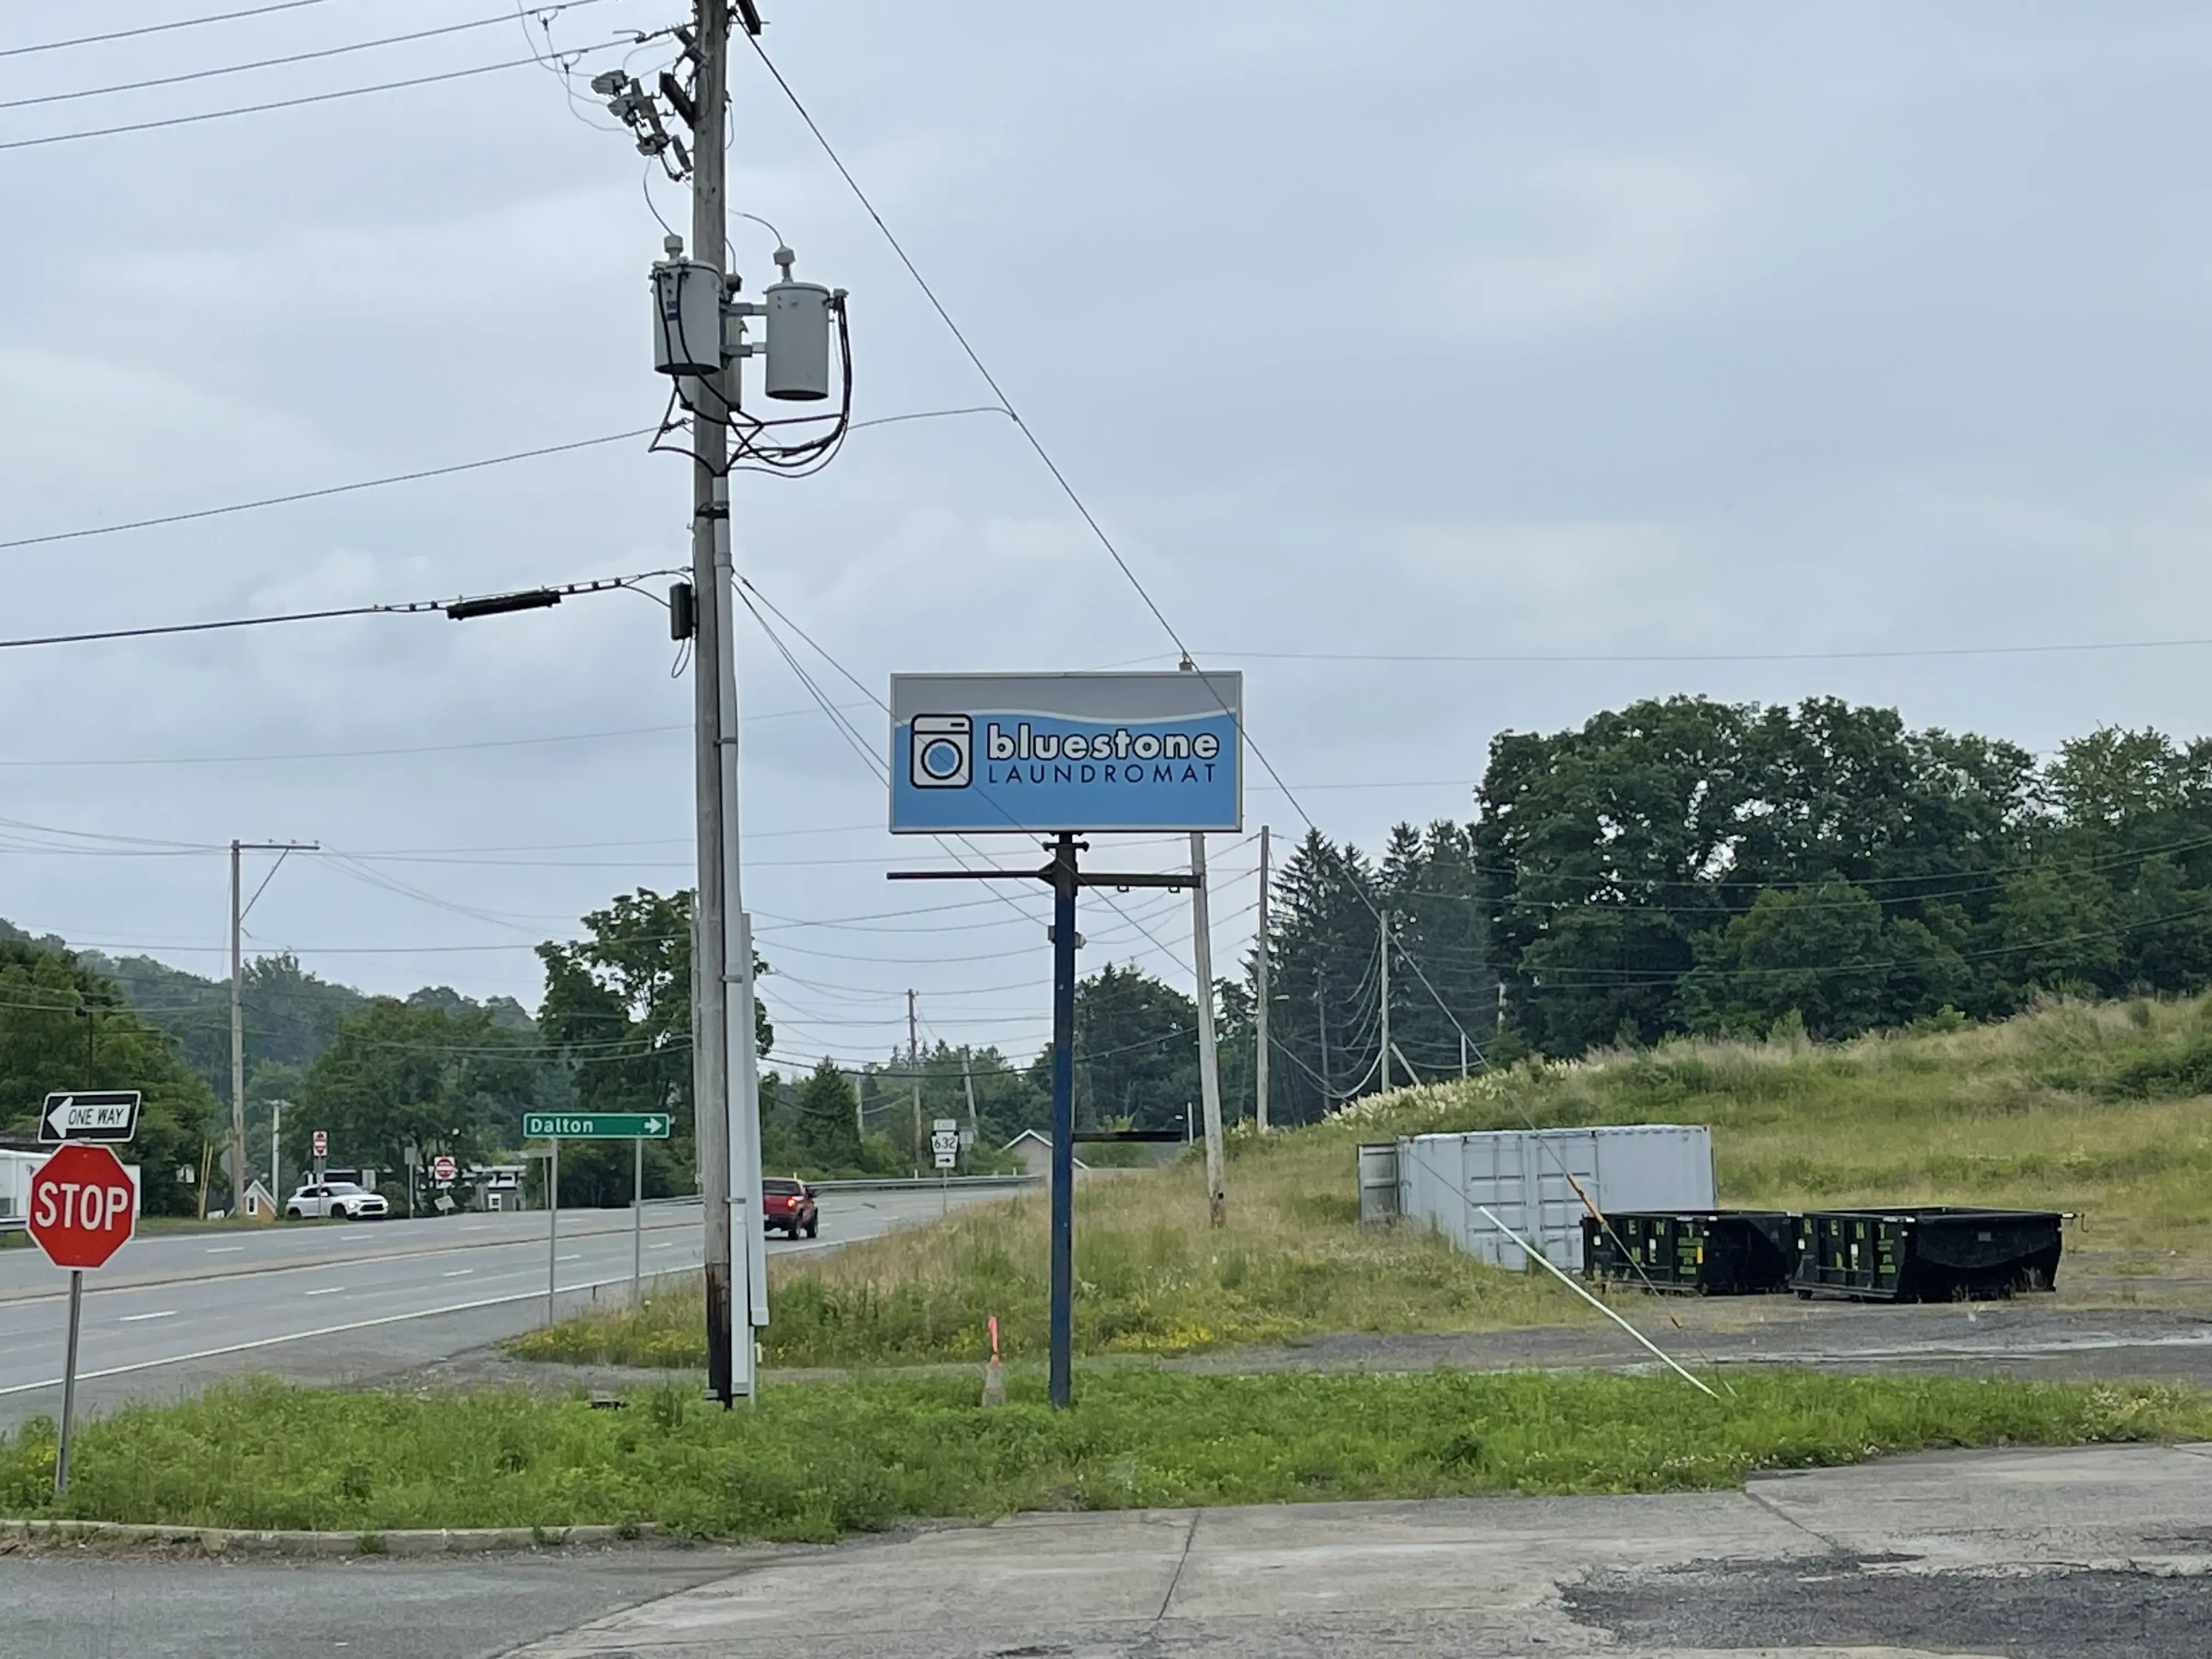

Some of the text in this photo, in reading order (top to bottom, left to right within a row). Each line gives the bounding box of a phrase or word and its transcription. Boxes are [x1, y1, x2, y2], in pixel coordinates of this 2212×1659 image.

[988, 723, 1220, 760] bluestone
[989, 764, 1216, 784] LAUNDROMAT
[68, 1108, 124, 1125] ONE WAY
[531, 1118, 594, 1133] Dalton
[935, 1137, 956, 1149] 632
[35, 1181, 128, 1231] STOP
[1601, 1219, 1696, 1239] ENT
